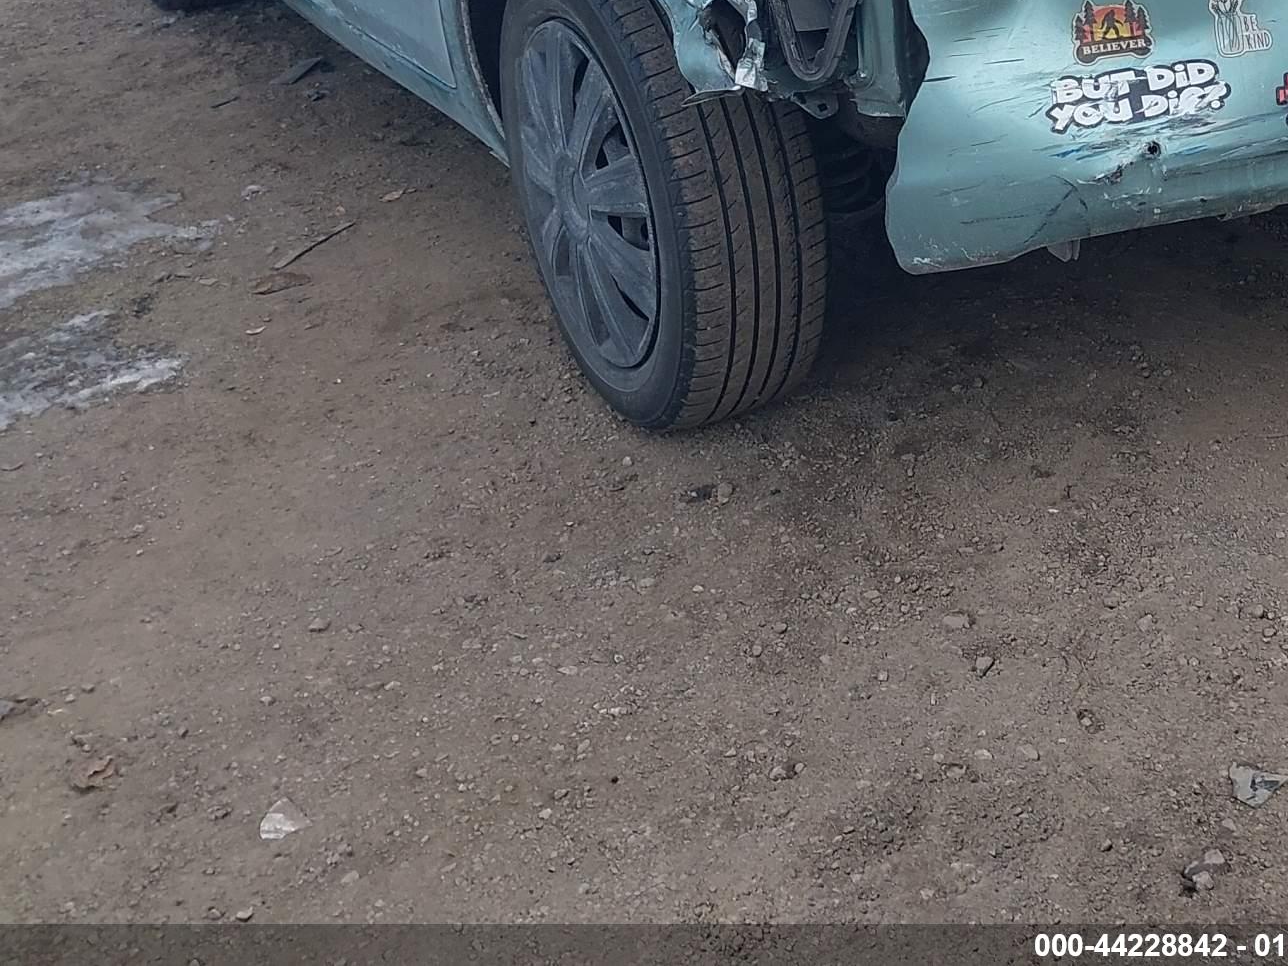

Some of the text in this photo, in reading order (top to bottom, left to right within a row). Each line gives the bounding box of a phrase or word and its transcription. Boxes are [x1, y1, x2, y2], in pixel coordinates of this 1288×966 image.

[1243, 15, 1257, 31] BE
[1083, 39, 1147, 55] BELIEVER
[1245, 33, 1271, 50] KIND
[1053, 71, 1136, 104] BUT
[1051, 98, 1134, 131] YOU
